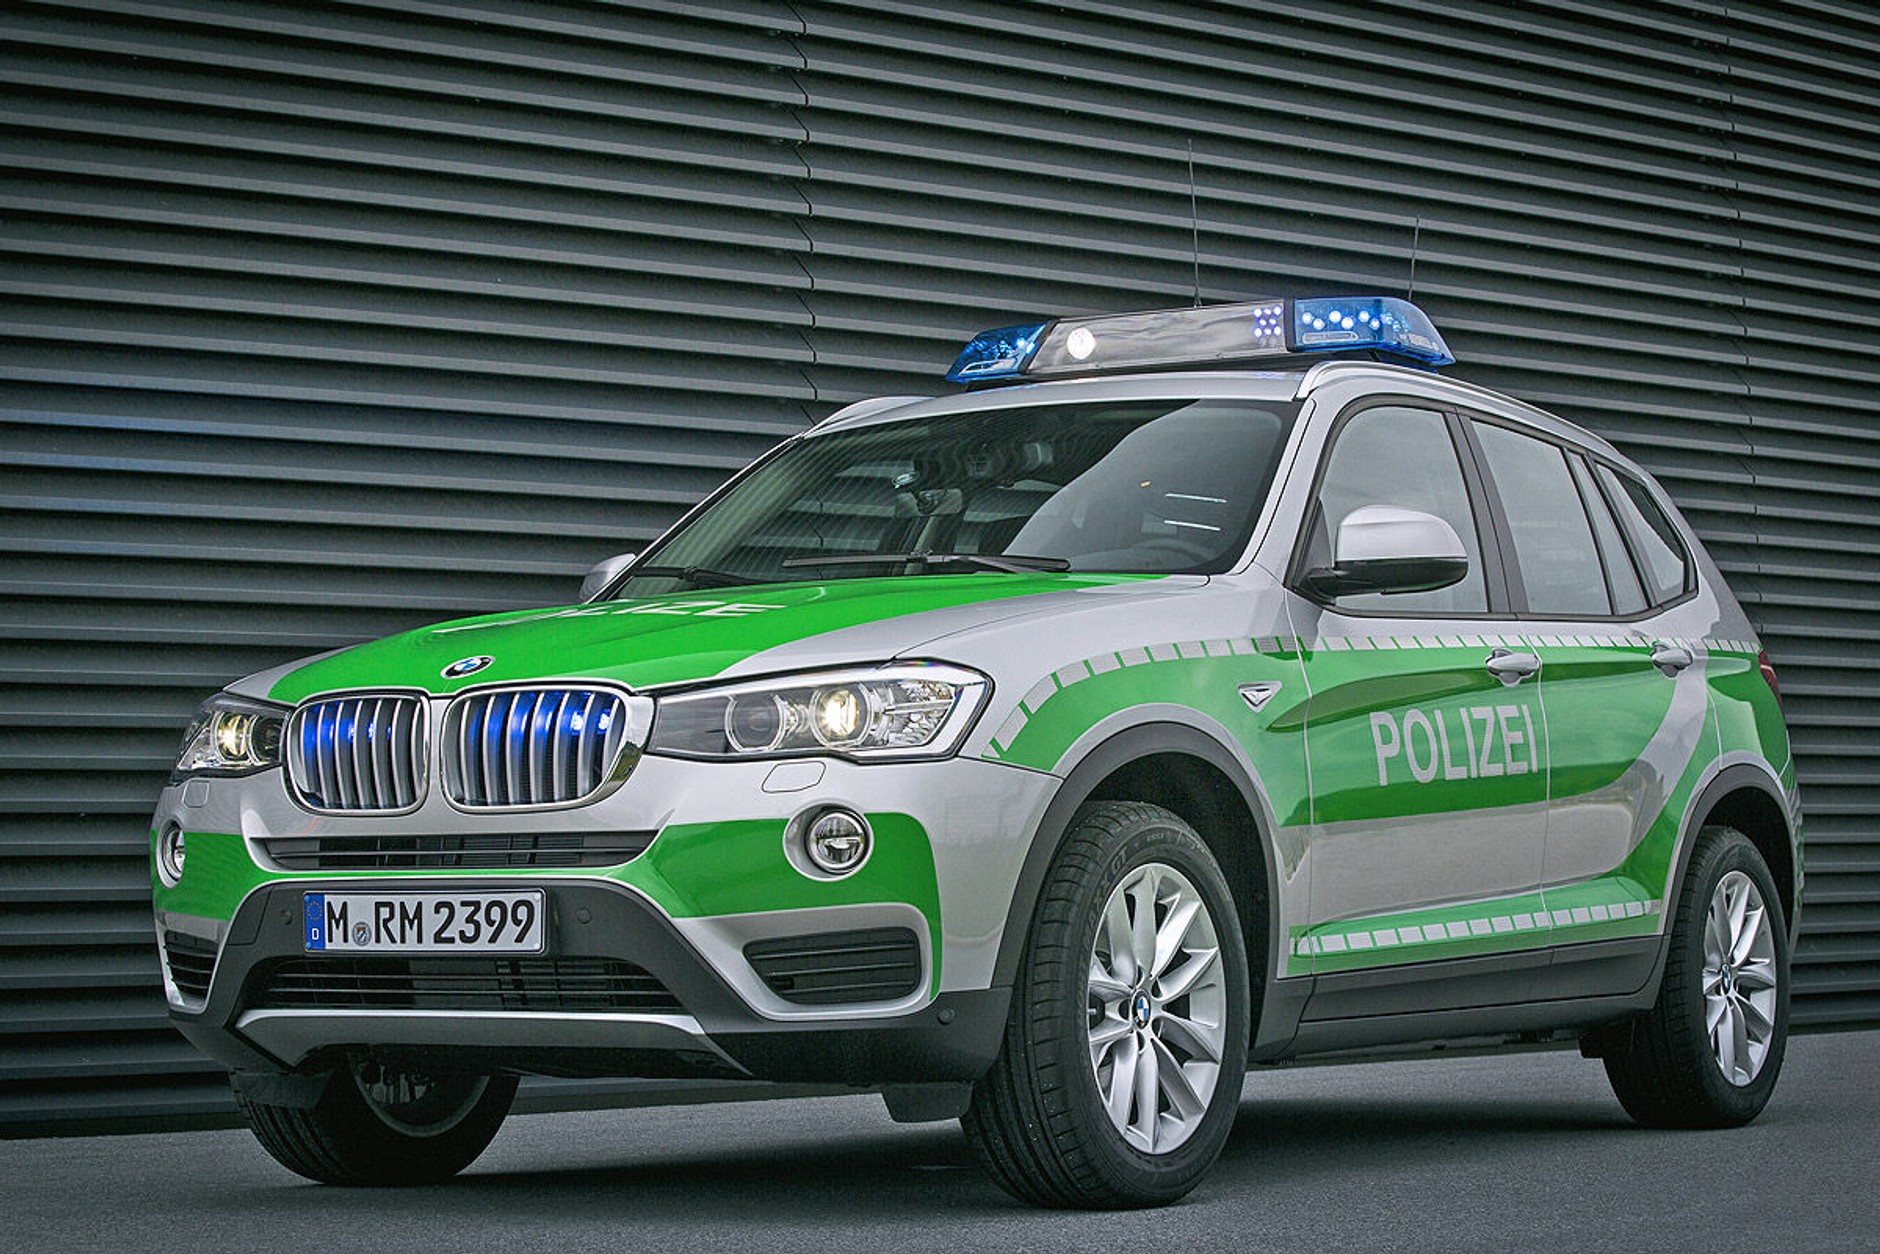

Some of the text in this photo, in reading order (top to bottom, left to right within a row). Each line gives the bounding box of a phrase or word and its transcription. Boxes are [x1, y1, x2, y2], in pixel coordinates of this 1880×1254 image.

[1370, 704, 1538, 786] POLIZEI
[311, 928, 320, 940] D
[327, 900, 536, 944] M RM 2399
